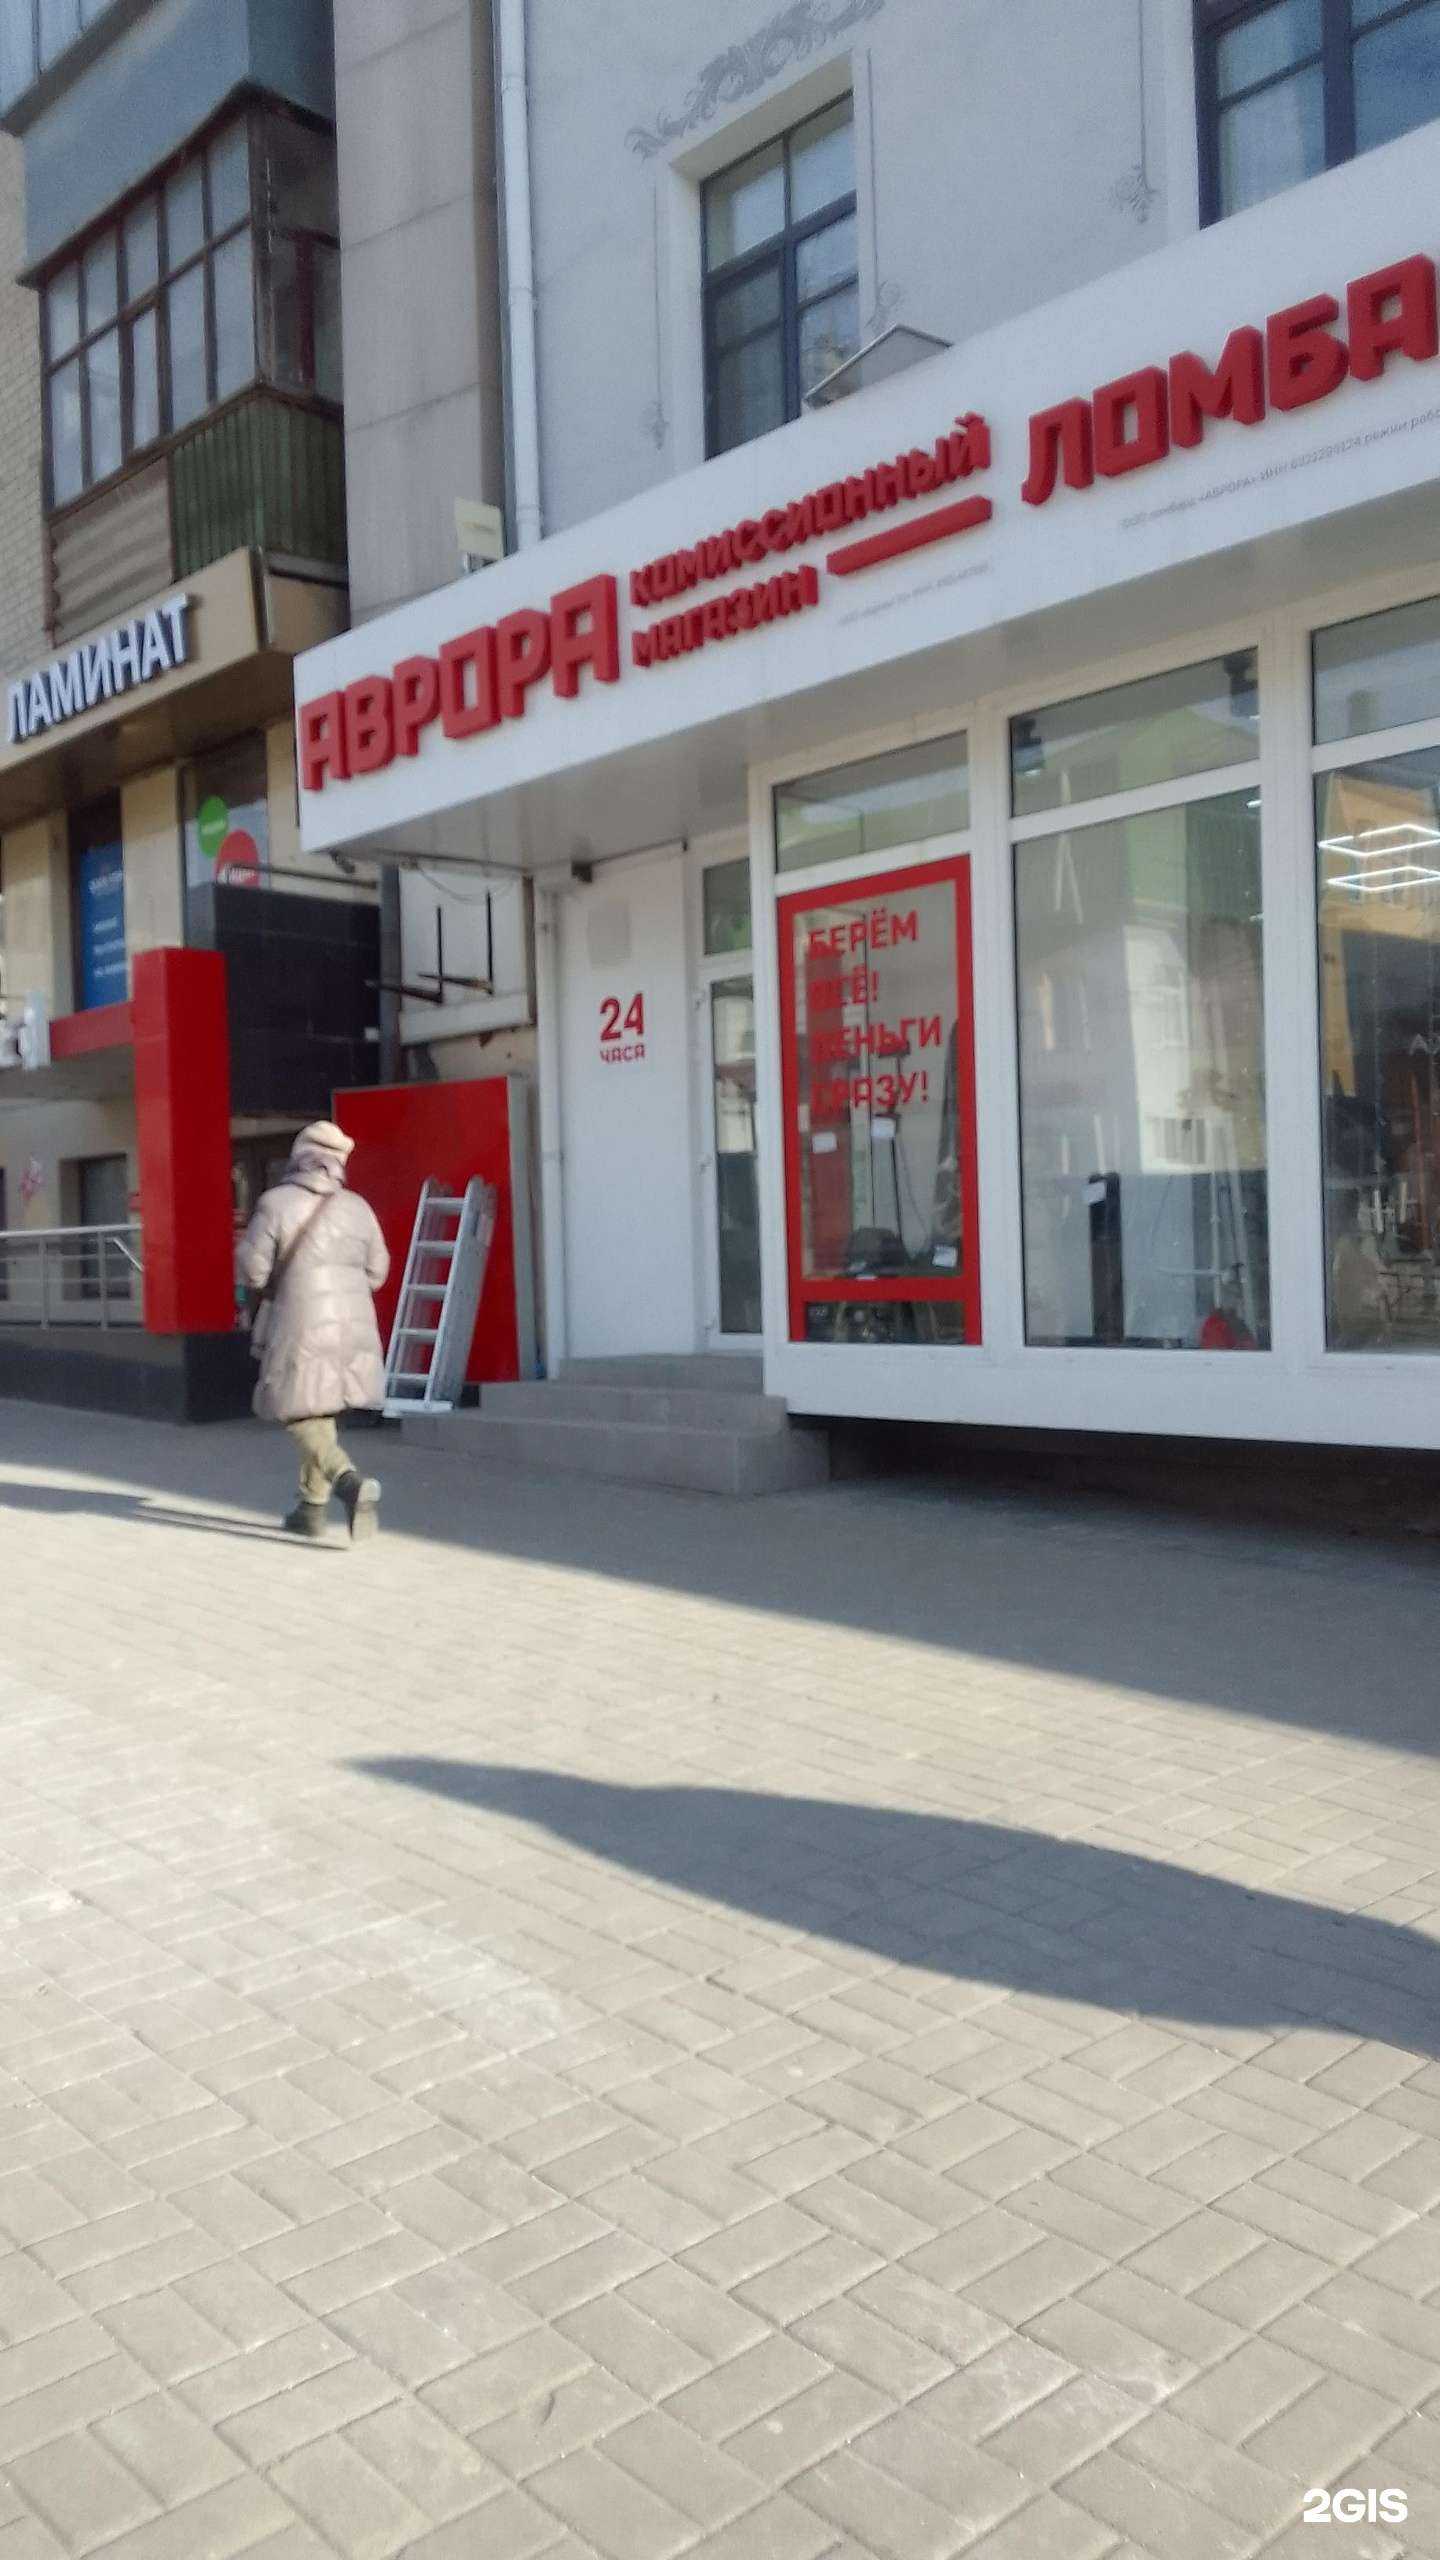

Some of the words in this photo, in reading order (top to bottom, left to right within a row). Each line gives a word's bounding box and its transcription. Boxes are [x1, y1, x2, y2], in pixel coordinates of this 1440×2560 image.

[1022, 253, 1440, 506] ЛОМБА
[629, 412, 992, 606] КОМИССИОННЫЙ
[8, 592, 188, 743] ЛАМИНАТ
[297, 573, 619, 792] АВРОРА
[632, 564, 819, 667] МАГАЗИН
[808, 908, 918, 960] БЕРЁМ
[599, 991, 645, 1041] 24
